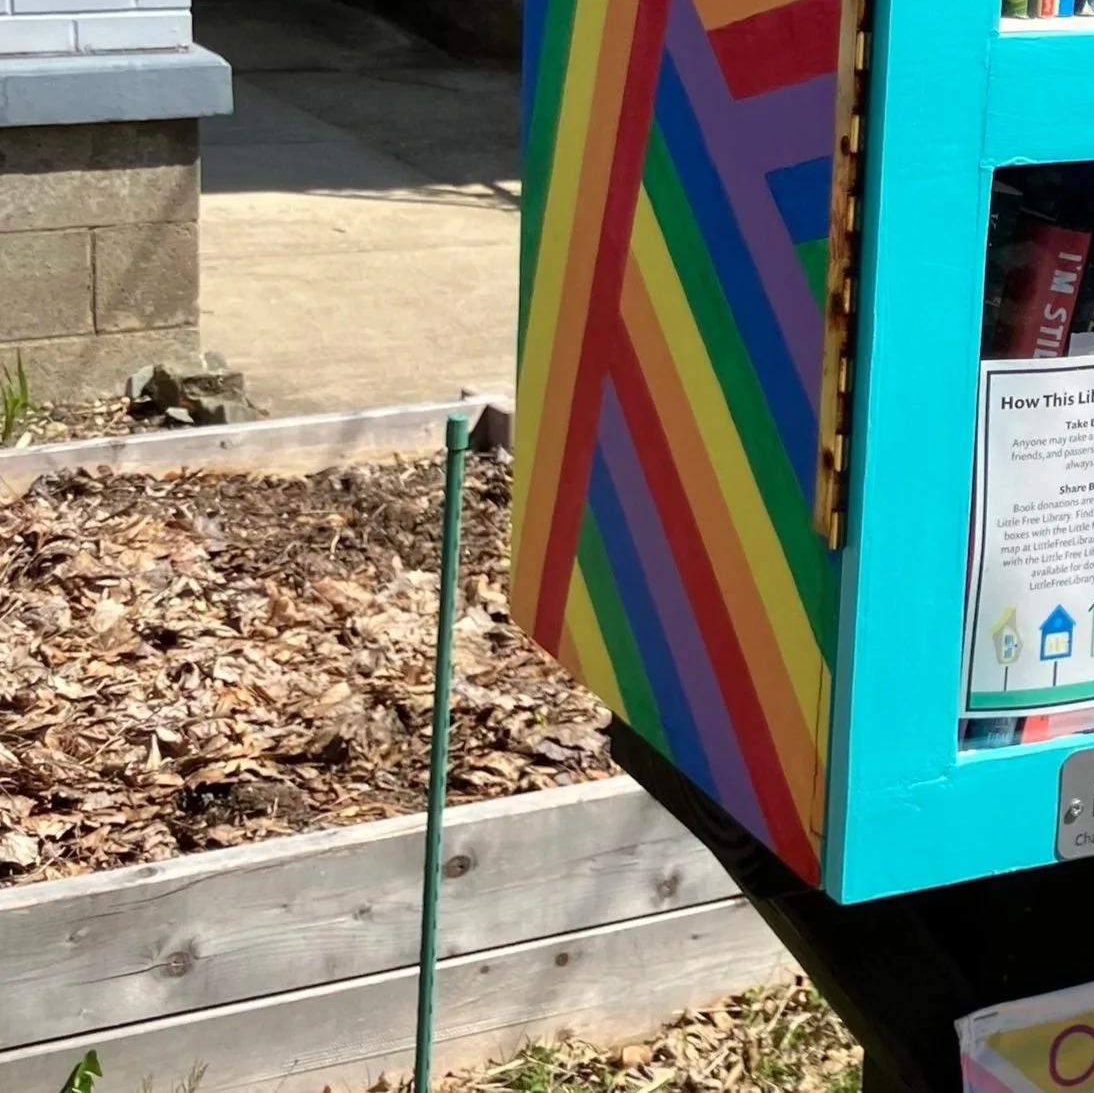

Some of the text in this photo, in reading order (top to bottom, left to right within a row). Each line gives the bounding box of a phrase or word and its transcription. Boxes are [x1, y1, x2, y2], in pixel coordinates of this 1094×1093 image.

[1050, 251, 1083, 295] I'M
[1001, 396, 1040, 410] How
[1043, 392, 1075, 408] This
[1066, 419, 1089, 430] Take
[1012, 437, 1047, 449] Anyone
[1049, 435, 1067, 446] may
[1069, 432, 1088, 443] take
[1011, 451, 1045, 462] friends,
[1046, 447, 1063, 459] and
[1065, 458, 1094, 471] always
[1059, 484, 1087, 495] Share
[1013, 502, 1036, 513] Book
[1037, 498, 1080, 510] donations
[1081, 497, 1094, 506] are
[997, 516, 1021, 528] Little
[1022, 514, 1041, 525] Free
[1075, 507, 1094, 518] Find
[1004, 529, 1030, 541] boxes
[1032, 526, 1052, 538] with
[1053, 524, 1067, 535] the
[1068, 520, 1090, 533] Little
[1001, 543, 1032, 555] map at
[1003, 556, 1024, 567] with
[1025, 554, 1040, 565] the
[1041, 551, 1063, 563] Little
[1064, 549, 1083, 560] Free
[1031, 565, 1069, 578] available
[1069, 563, 1082, 573] for
